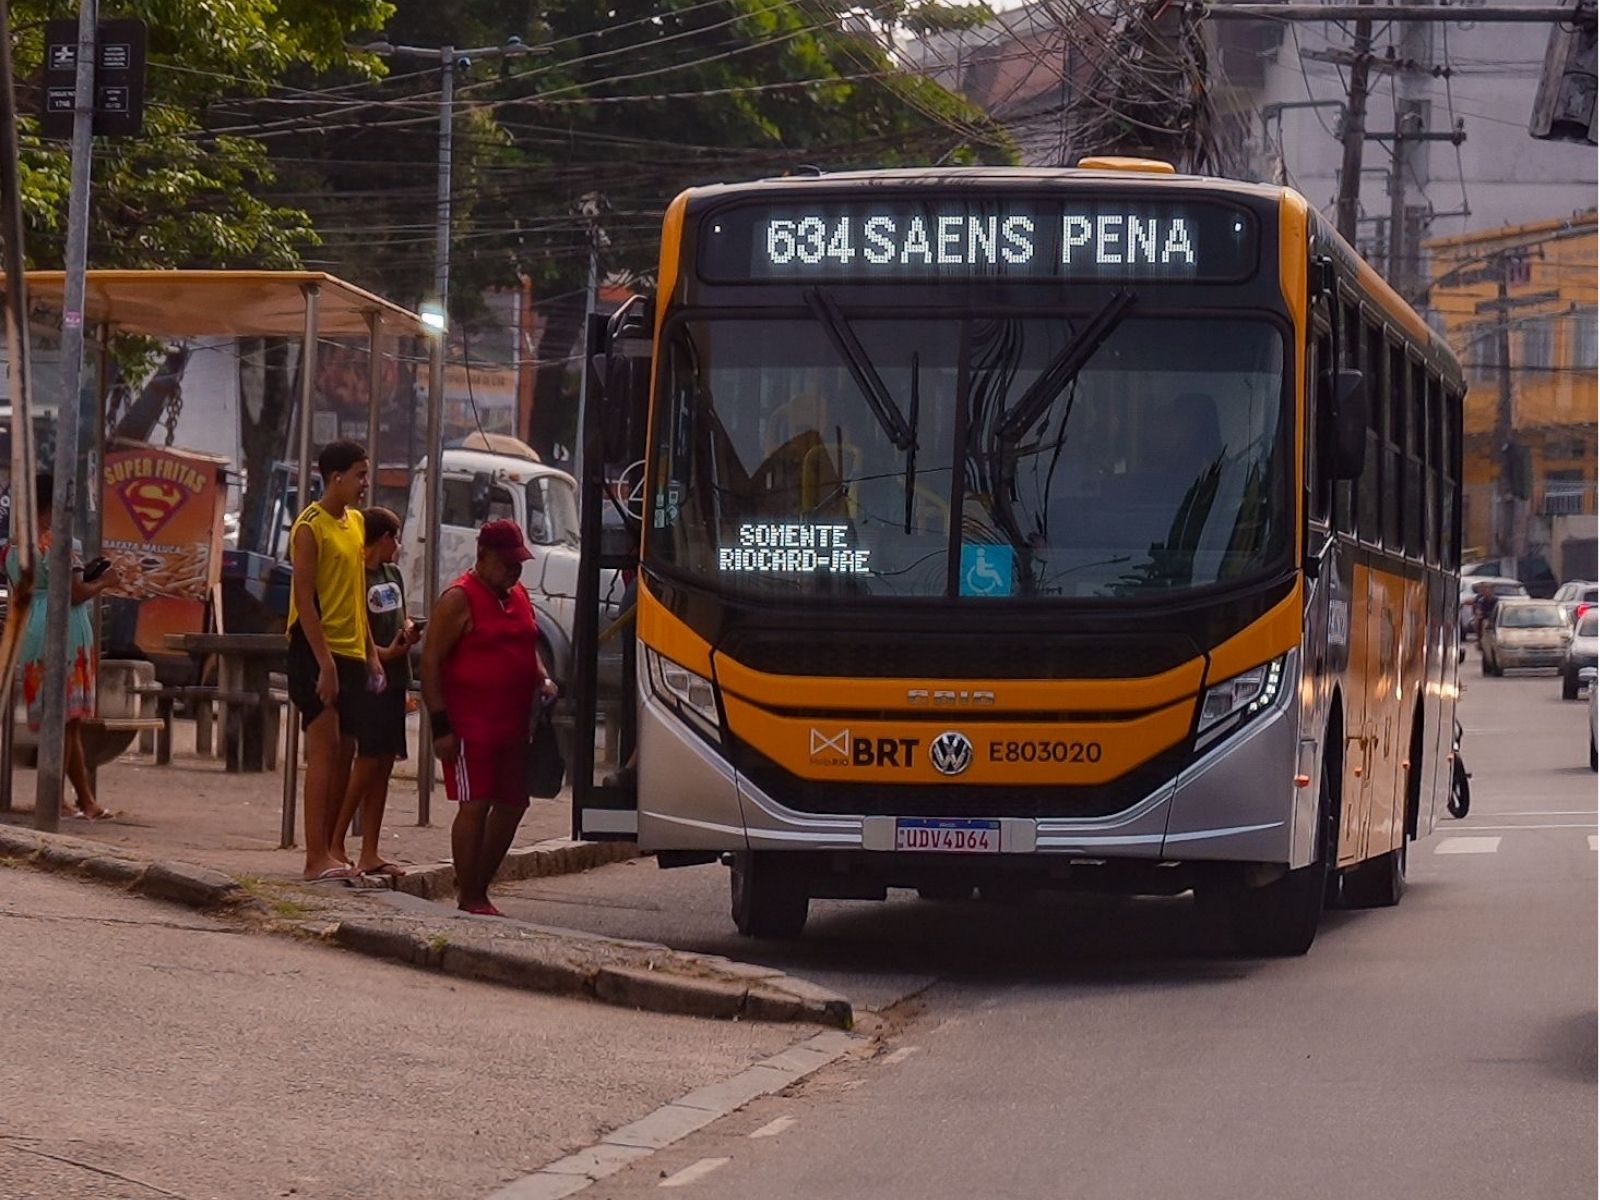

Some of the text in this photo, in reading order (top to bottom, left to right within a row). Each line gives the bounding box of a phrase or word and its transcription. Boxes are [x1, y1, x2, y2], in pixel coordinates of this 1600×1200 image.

[767, 215, 1195, 264] 634 SAENS PENA
[104, 459, 152, 485] SUPER
[156, 460, 206, 493] FRITAS
[739, 524, 848, 548] SOMENTE
[719, 548, 871, 573] RIOCARD-JAE
[852, 737, 919, 768] BRT
[989, 741, 1102, 763] E803020
[907, 830, 989, 850] UDV4D64
